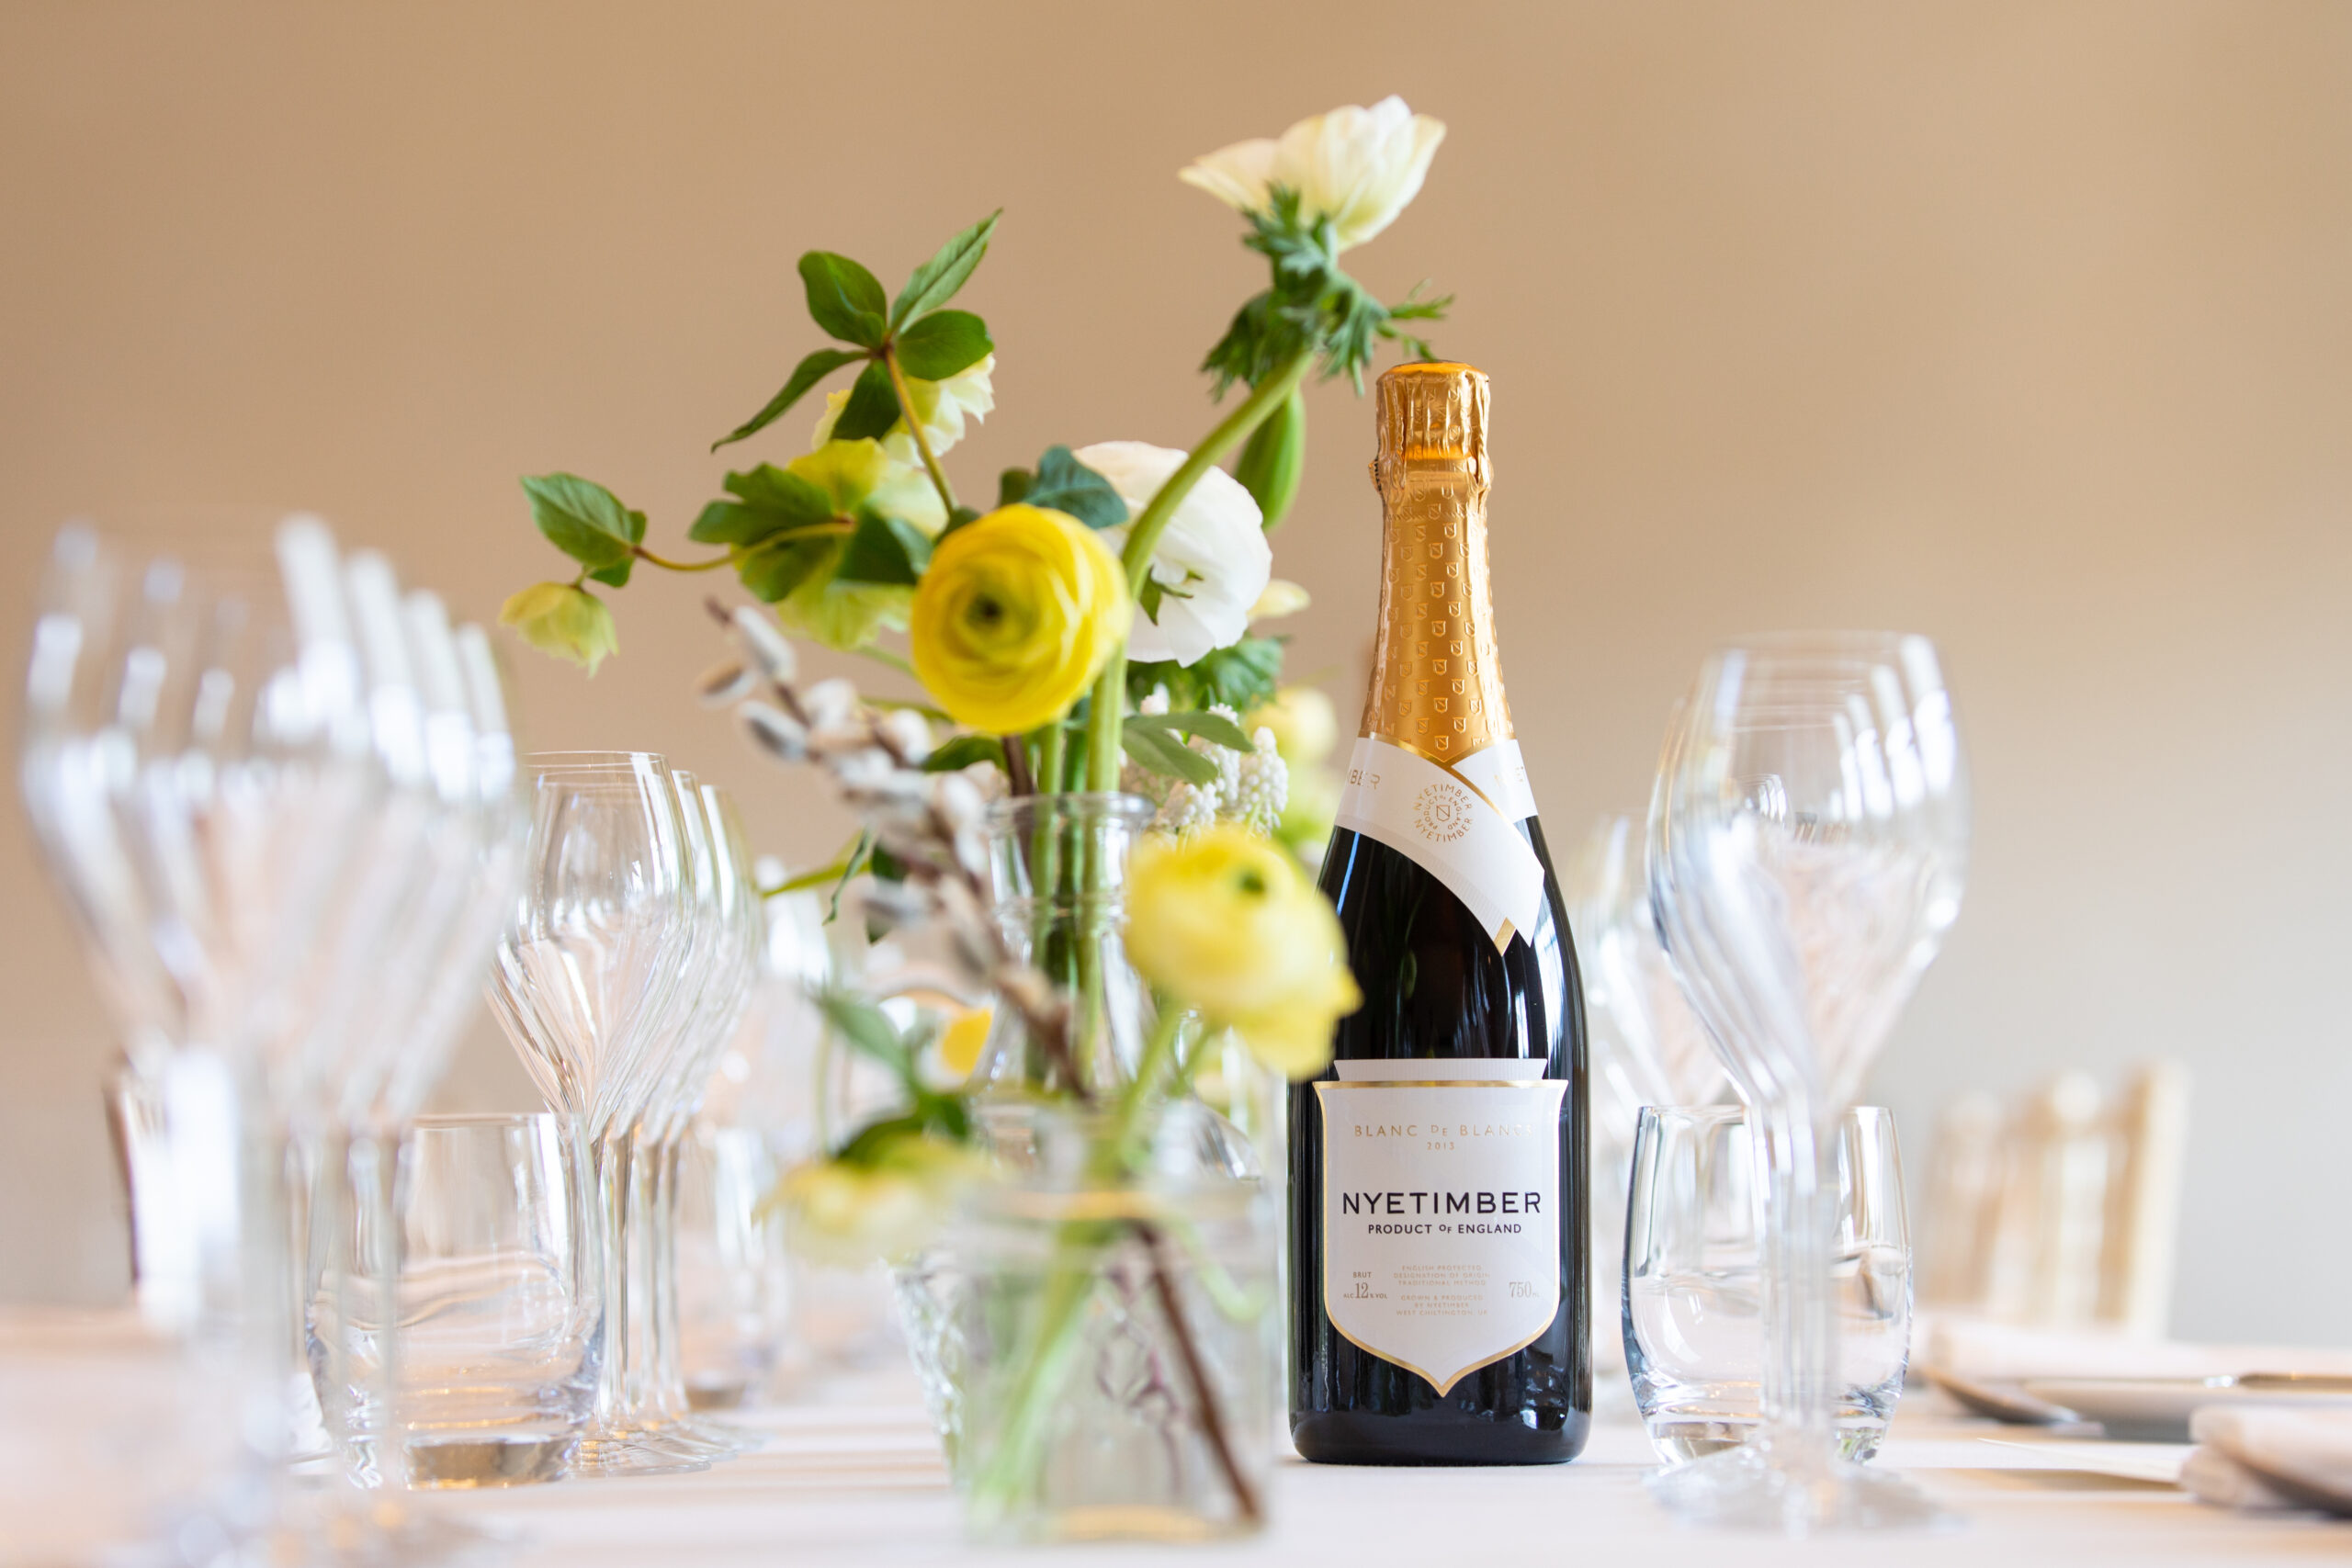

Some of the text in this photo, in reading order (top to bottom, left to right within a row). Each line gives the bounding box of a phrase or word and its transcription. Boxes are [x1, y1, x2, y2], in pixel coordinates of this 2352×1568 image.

[1412, 784, 1473, 811] NYETIMBER
[1413, 818, 1473, 842] NYETIMBER
[1354, 1124, 1419, 1137] BLANC
[1426, 1141, 1455, 1151] 2013
[1342, 1191, 1542, 1214] NYETIMBER
[1368, 1224, 1432, 1235] PRODUCT
[1457, 1224, 1521, 1235] ENGLAND
